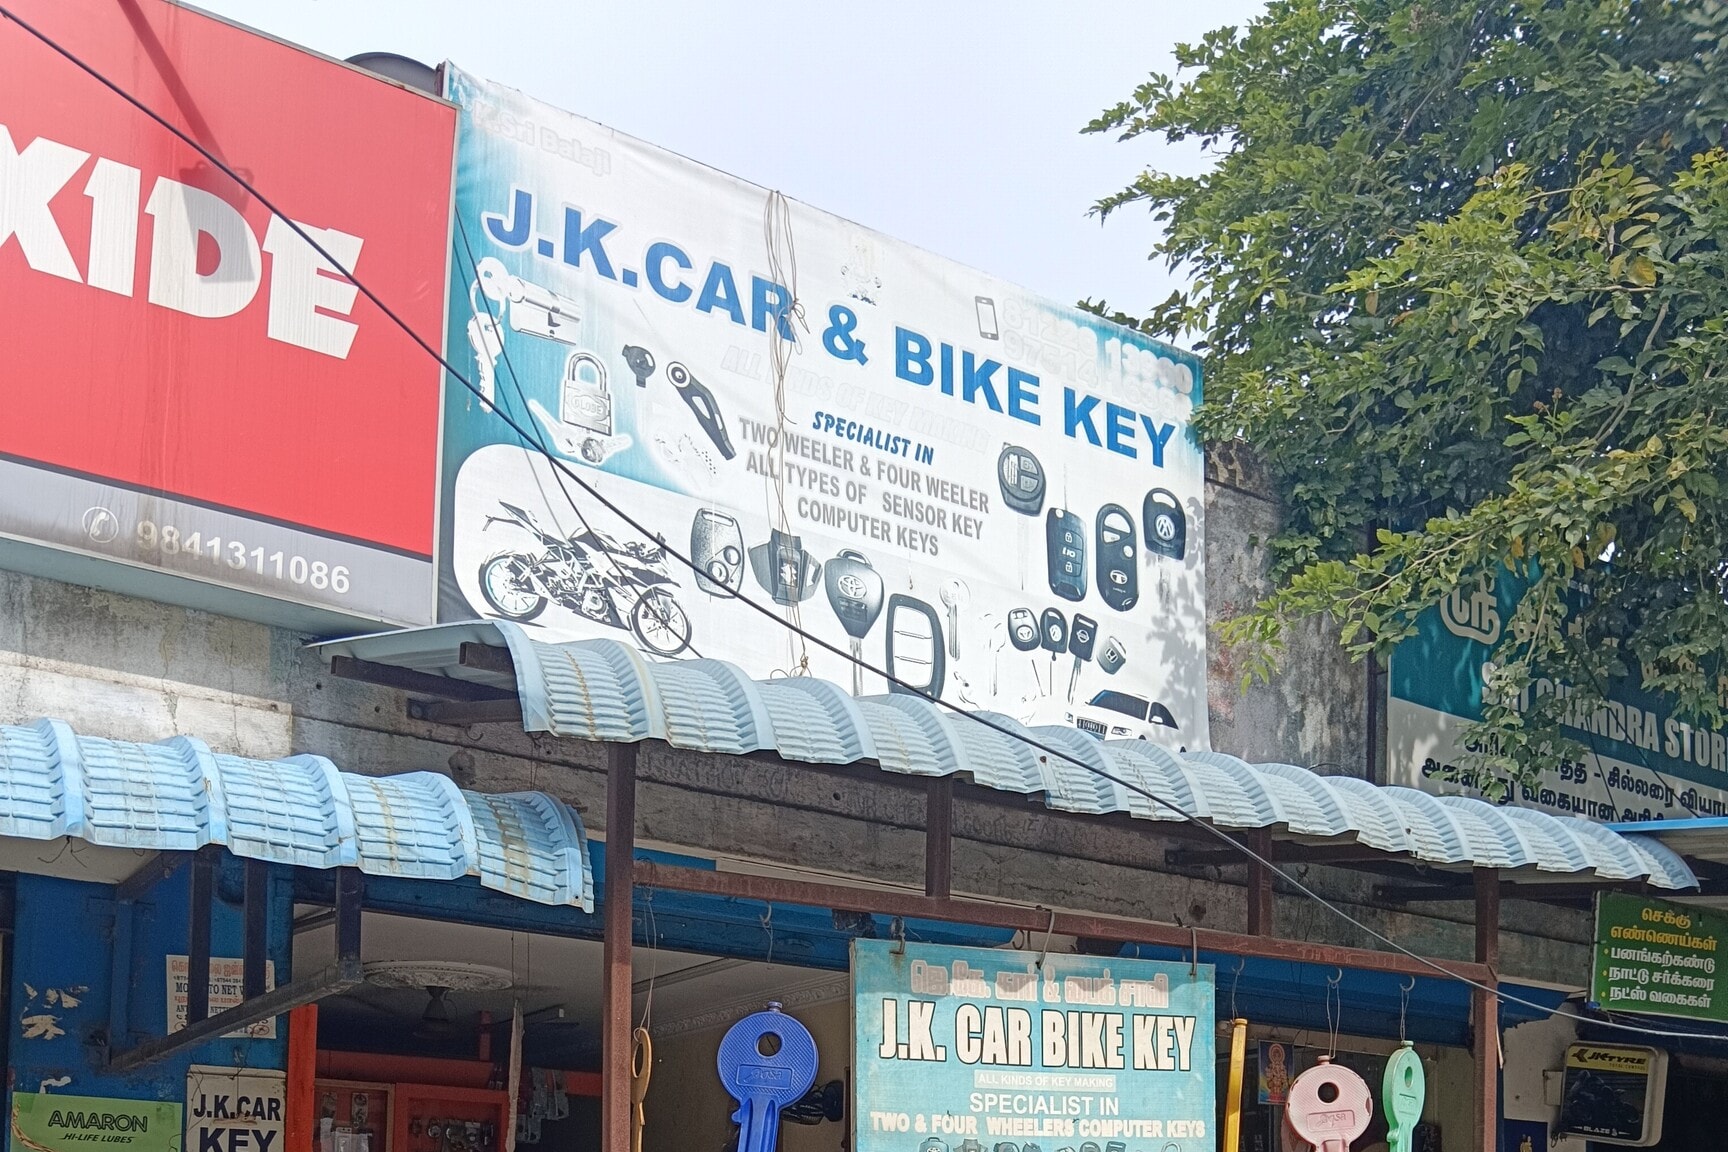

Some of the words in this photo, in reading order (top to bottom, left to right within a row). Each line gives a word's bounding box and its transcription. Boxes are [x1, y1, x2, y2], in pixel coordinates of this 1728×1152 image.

[486, 188, 796, 343] J.K.CAR
[822, 304, 869, 366] &
[895, 326, 1041, 426] BIKE
[1063, 386, 1176, 469] KEY
[812, 411, 912, 458] SPECIALIST
[914, 443, 935, 466] IN
[739, 417, 779, 448] TWO
[784, 431, 854, 472] WEELER
[860, 455, 872, 477] &
[877, 460, 922, 494] FOUR
[926, 475, 989, 514] WEELER
[746, 452, 780, 481] ALL
[784, 461, 841, 498] TYPES
[845, 480, 868, 505] OF
[882, 492, 948, 530] SENSOR
[952, 512, 984, 540] KEY
[797, 496, 892, 543] COMPUTER
[896, 524, 939, 557] KEYS
[136, 520, 350, 594] 9841311086
[1664, 717, 1728, 773] STOR
[1642, 908, 1691, 929] செக்கு
[1611, 925, 1717, 951] எண்ணெய்கள்
[1611, 947, 1715, 974] பனங்கற்கண்டு
[1608, 966, 1649, 984] நாட்டு
[1651, 970, 1715, 991] சர்க்கரை
[1608, 985, 1647, 1001] நட்ஸ்
[1649, 991, 1711, 1008] வகைகள்
[879, 998, 947, 1062] J.K.
[955, 1003, 1032, 1067] CAR
[1041, 1009, 1125, 1069] BIKE
[1132, 1014, 1196, 1072] KEY
[978, 1074, 999, 1086] ALL
[1001, 1075, 1033, 1087] KINDS
[1034, 1075, 1049, 1087] OF
[1050, 1076, 1073, 1088] KEY
[1075, 1076, 1113, 1089] MAKING
[193, 1095, 281, 1122] J.K.CAR
[969, 1091, 1094, 1116] SPECIALIST
[1099, 1097, 1119, 1115] IN
[48, 1110, 148, 1132] AMARON
[870, 1111, 910, 1131] TWO
[914, 1113, 928, 1133] &
[932, 1115, 977, 1135] FOUR
[986, 1116, 1074, 1137] WHEELERS
[1078, 1119, 1163, 1138] COMPUTER
[1166, 1119, 1206, 1138] KEYS
[60, 1133, 99, 1141] HI-LIFE
[101, 1135, 134, 1143] LUBES
